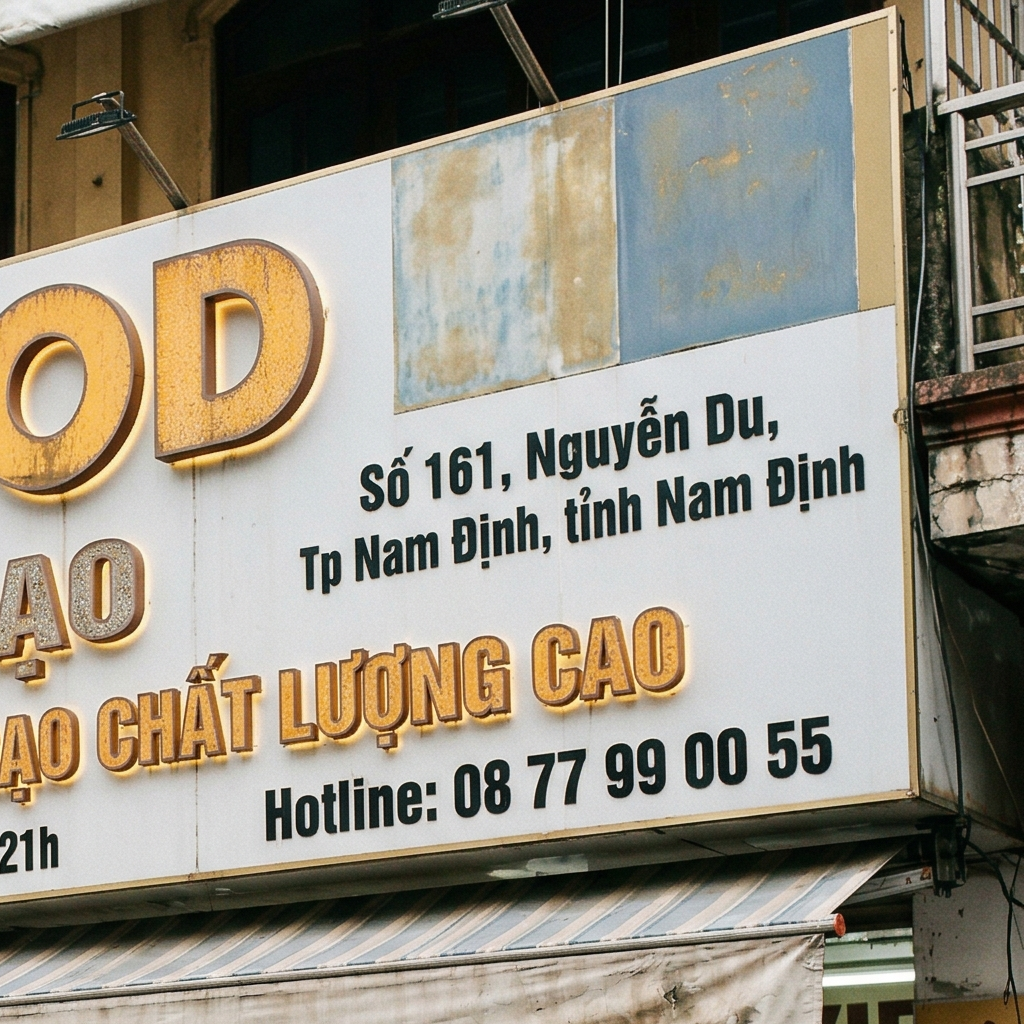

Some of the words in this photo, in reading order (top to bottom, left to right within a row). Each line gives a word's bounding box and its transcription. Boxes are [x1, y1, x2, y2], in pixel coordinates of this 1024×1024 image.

[300, 546, 342, 594] Tp
[355, 532, 439, 581] Nam
[451, 505, 551, 569] Định,
[564, 487, 642, 543] tỉnh
[657, 473, 751, 527] Nam
[766, 445, 865, 512] Định
[359, 446, 413, 512] Số
[425, 441, 511, 499] 161,
[527, 395, 690, 481] Nguyễn
[706, 393, 778, 446] Du,
[97, 653, 262, 772] CHẤT
[278, 635, 511, 750] LƯỢNG
[531, 606, 686, 707] CAO
[265, 777, 438, 841] Hotline:
[454, 759, 510, 818] 08
[527, 748, 587, 809] 77
[606, 738, 666, 798] 99
[685, 727, 747, 789] 00
[768, 715, 832, 778] 55
